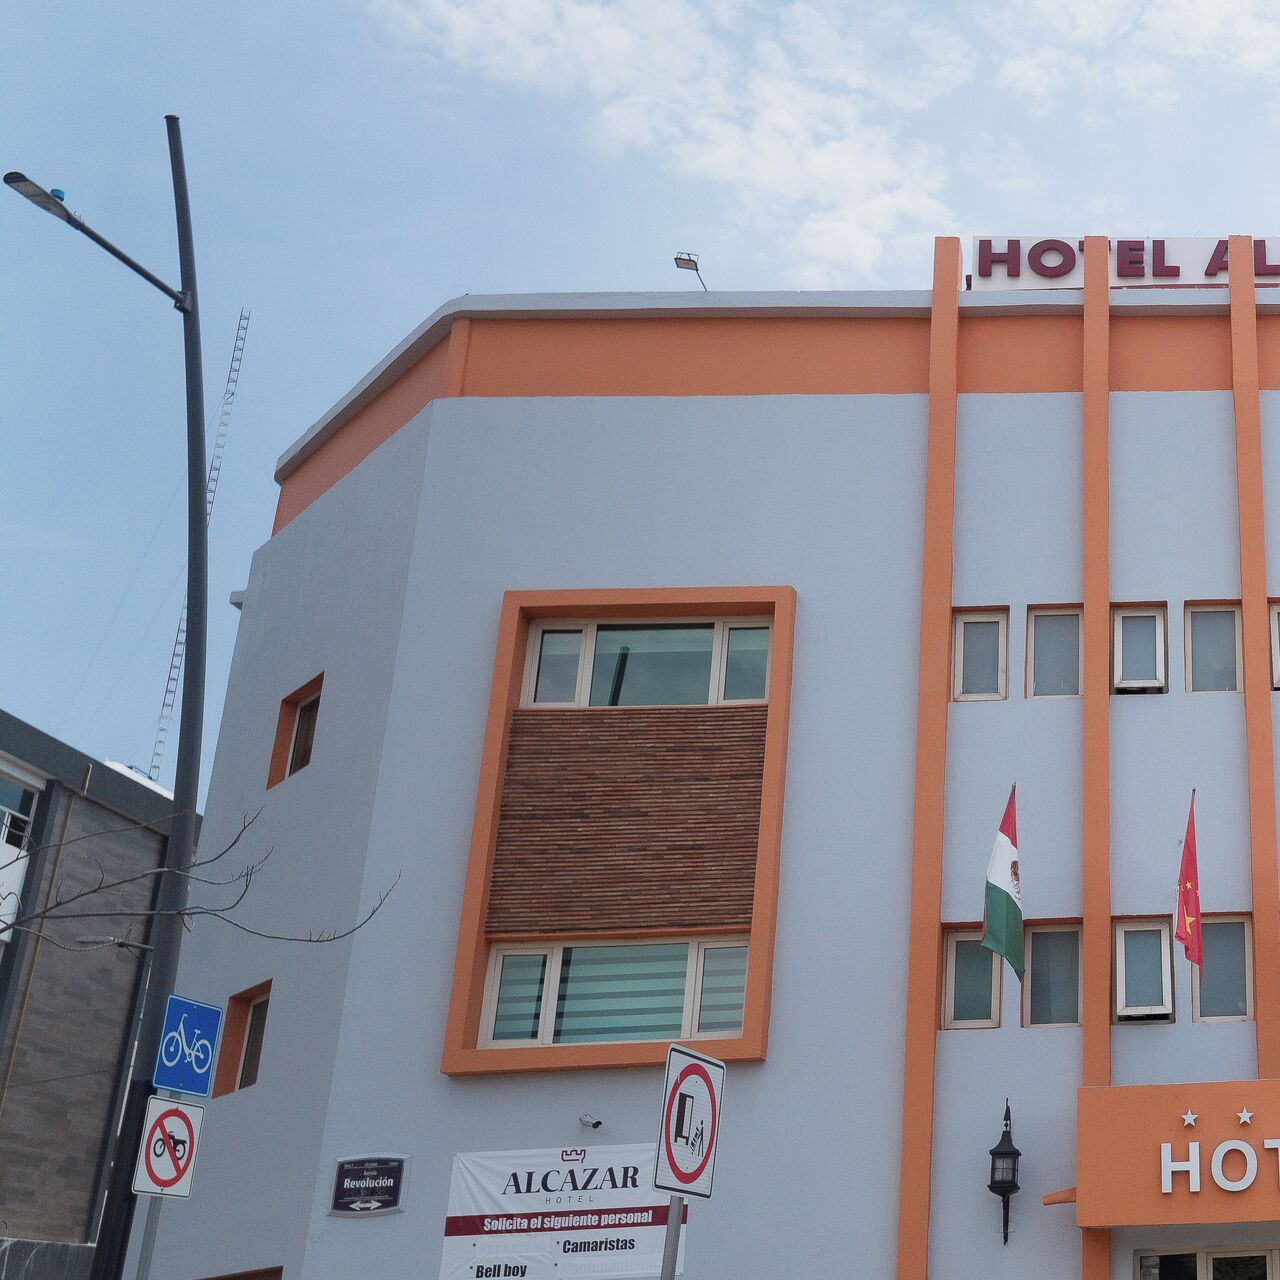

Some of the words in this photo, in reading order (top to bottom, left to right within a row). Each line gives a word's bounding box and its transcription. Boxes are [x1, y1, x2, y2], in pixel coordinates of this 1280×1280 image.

[979, 239, 1180, 278] HOEL
[343, 1176, 394, 1189] Revolución
[501, 1166, 640, 1195] ALCAZAR
[545, 1195, 595, 1205] HOTEL
[483, 1215, 528, 1232] Solicita
[529, 1214, 542, 1229] el
[543, 1213, 599, 1230] siguiente
[600, 1210, 653, 1227] personal
[562, 1237, 636, 1254] Camaristas
[475, 1264, 501, 1279] Bell
[503, 1263, 528, 1278] boy
